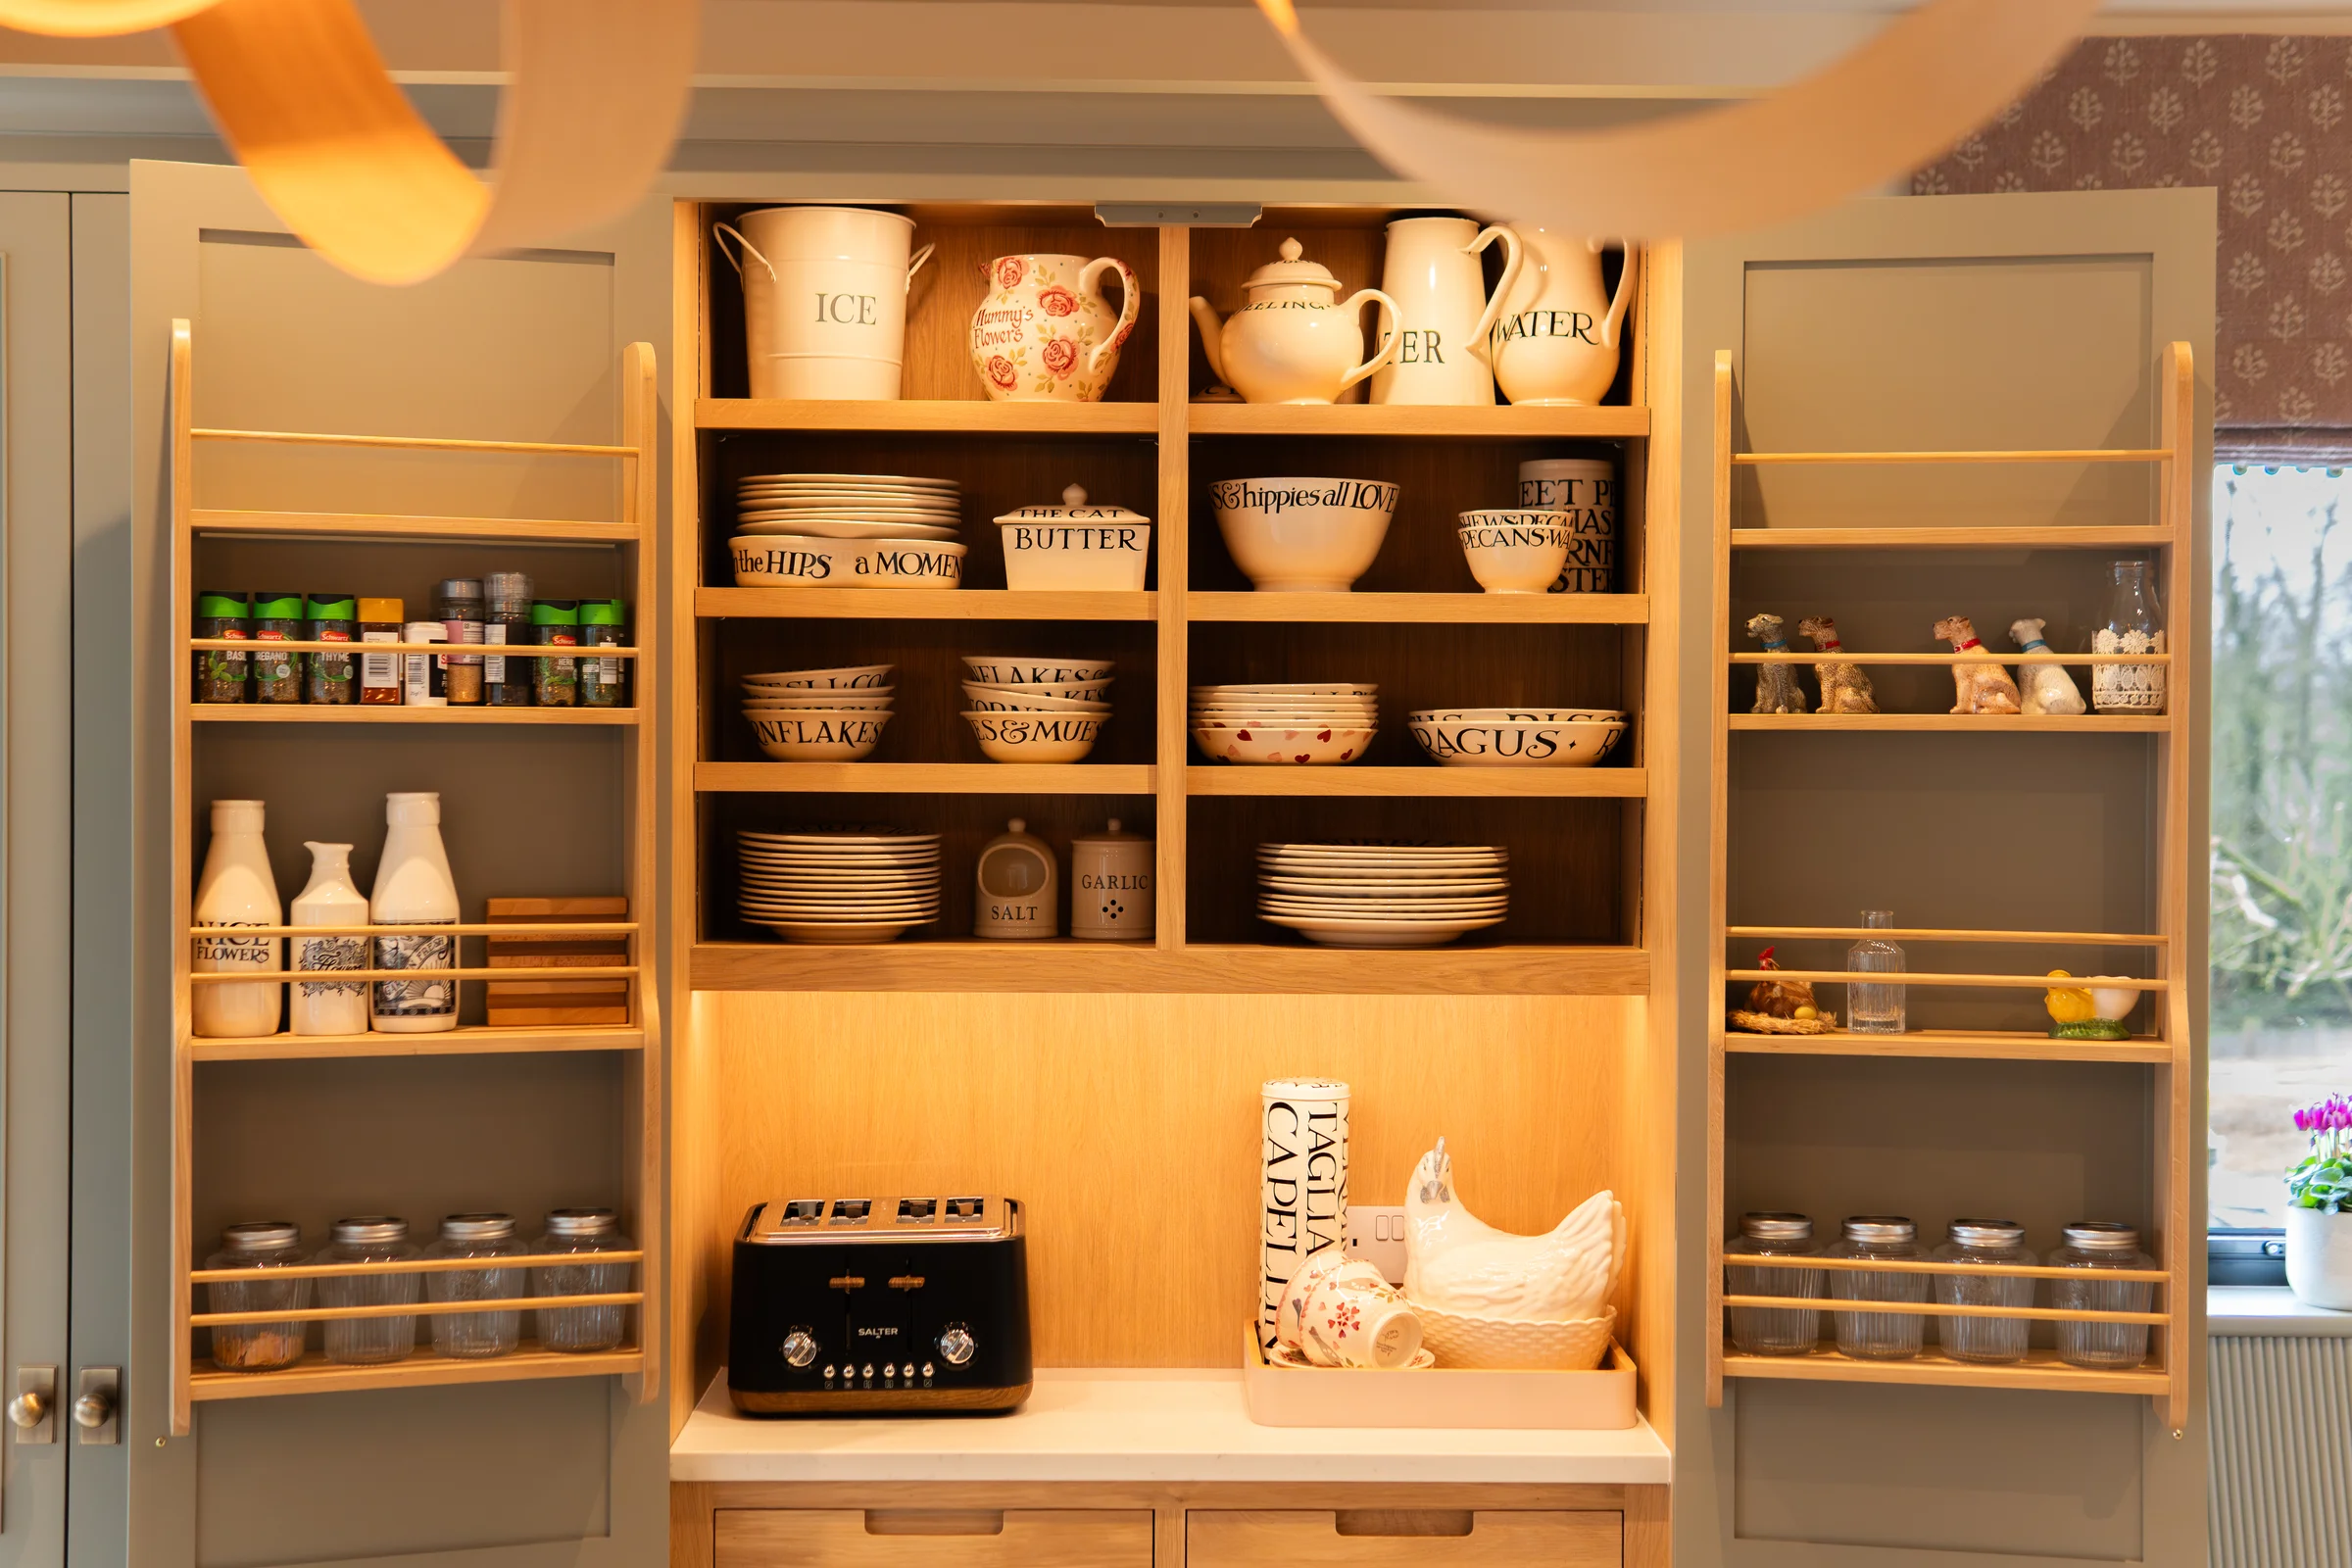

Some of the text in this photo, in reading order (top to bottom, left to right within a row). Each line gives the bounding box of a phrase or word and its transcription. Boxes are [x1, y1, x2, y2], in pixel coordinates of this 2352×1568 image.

[814, 293, 877, 325] ICE
[973, 306, 1034, 328] Mummy's
[974, 328, 1024, 349] Flowers
[1496, 311, 1600, 346] WATER
[1242, 482, 1321, 514] hippies
[1322, 481, 1351, 507] all
[1015, 509, 1125, 518] THE CAT
[1014, 527, 1143, 552] BUTTER
[739, 549, 763, 572] the
[765, 550, 833, 579] HIPS
[855, 557, 870, 574] a
[320, 652, 350, 662] THYME
[1081, 874, 1149, 890] GARLIC
[991, 906, 1038, 920] SALT
[196, 947, 270, 964] FLOWERS
[858, 1328, 899, 1337] SALTER
